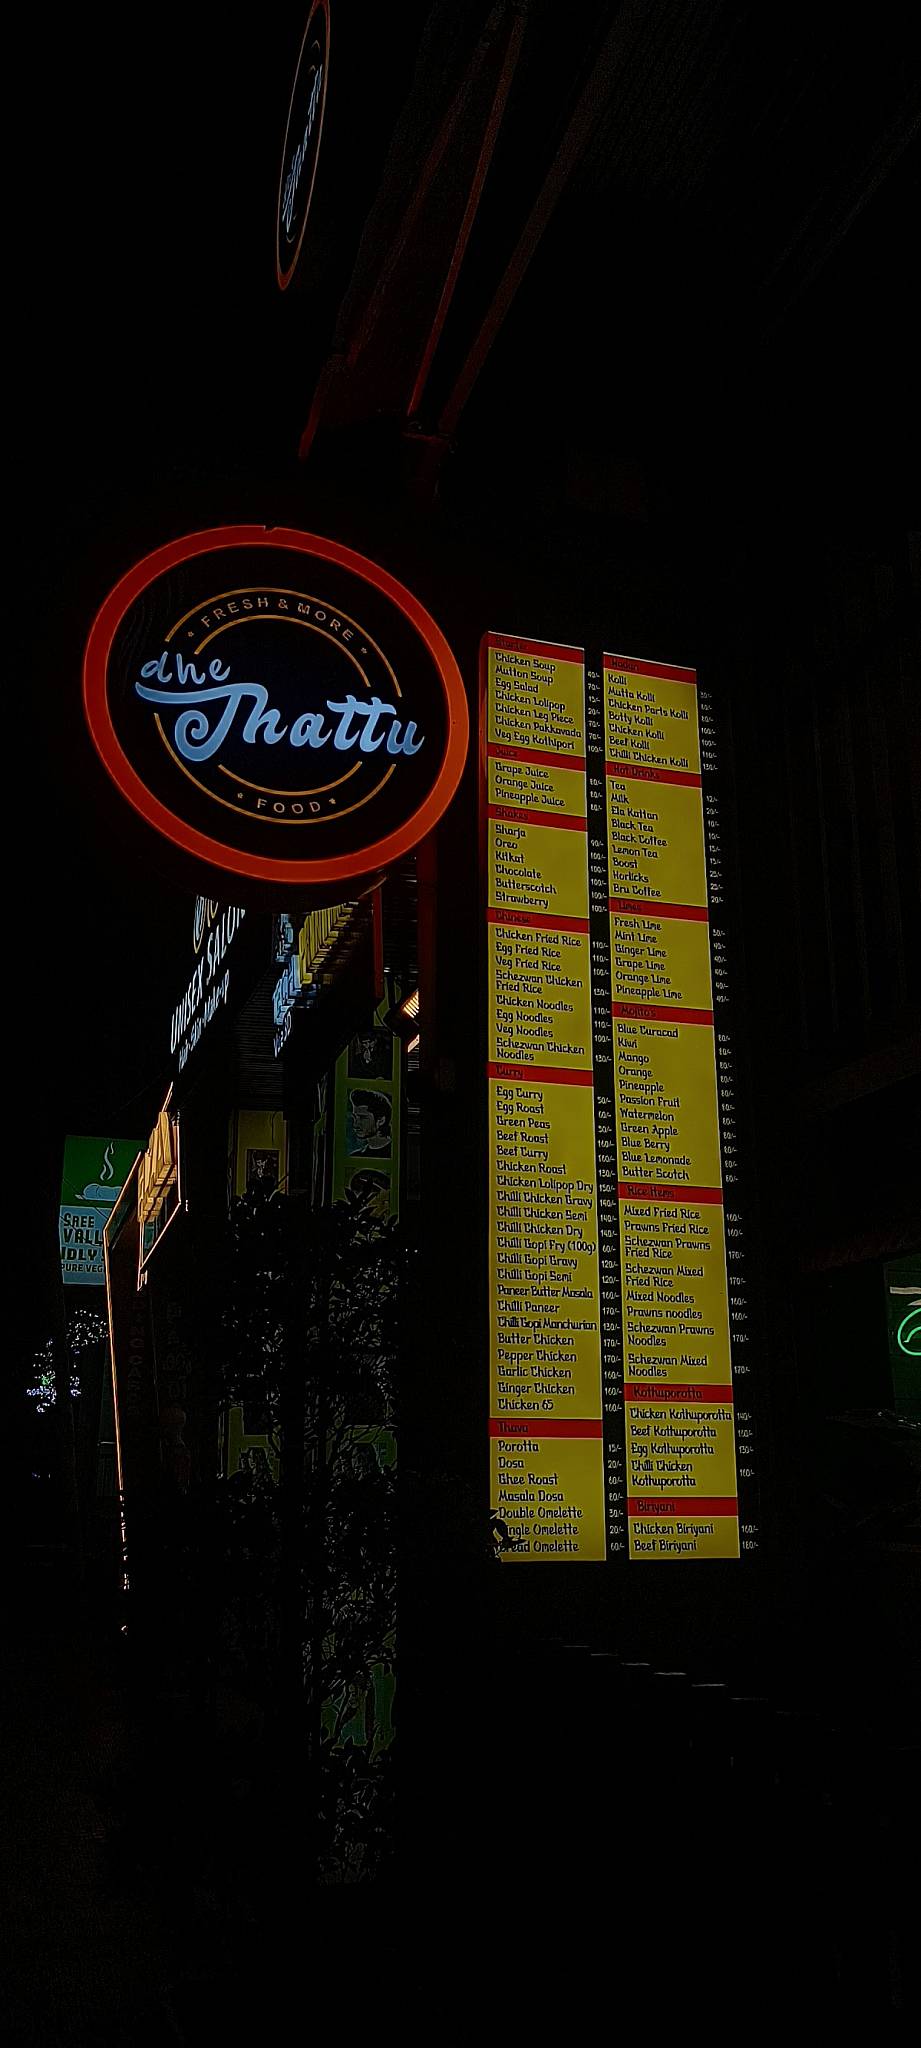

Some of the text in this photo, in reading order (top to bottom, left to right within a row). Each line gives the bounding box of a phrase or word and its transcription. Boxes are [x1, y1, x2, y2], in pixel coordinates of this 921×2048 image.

[201, 597, 355, 641] FRESH & MORE
[495, 676, 538, 693] Egg Salad
[607, 673, 627, 685] Kolli
[636, 690, 655, 703] Kolli
[135, 682, 425, 762] Thattu
[494, 714, 531, 730] Chicken
[494, 761, 549, 778] Grape Juice
[609, 779, 626, 791] Tea
[256, 797, 321, 814] FOOD
[610, 792, 629, 804] Milk
[495, 837, 518, 849] Oreo
[611, 831, 668, 846] Black Coffee
[495, 850, 524, 864] Kitkat
[612, 856, 637, 869] Boost
[494, 863, 542, 879] Chocolate
[612, 869, 649, 883] Horlicks
[495, 877, 557, 894] Butterscotch
[495, 890, 548, 909] Strawberry
[495, 927, 582, 947] Chicken Fried Rice
[615, 970, 671, 986] Orange Lime
[171, 956, 204, 1054] UNISEX
[496, 1008, 553, 1024] Egg Noodles
[617, 1036, 637, 1048] Kiwi
[618, 1050, 649, 1066] Mango
[618, 1064, 653, 1080] Orange
[496, 1085, 543, 1102] Egg Curry
[618, 1078, 664, 1096] Pineapple
[496, 1100, 544, 1115] Egg Roast
[619, 1107, 674, 1122] Watermelon
[495, 1115, 550, 1129] Green Peas
[496, 1129, 548, 1144] Beef Roast
[621, 1165, 690, 1180] Butter Scotch
[496, 1174, 536, 1188] Chicken
[576, 1180, 594, 1194] Dry
[496, 1190, 592, 1209] Chilli Chicken Gravy
[623, 1204, 701, 1219] Mixed Fried Rice
[64, 1213, 95, 1228] SREE
[623, 1219, 709, 1234] Prawns Fried Rice
[496, 1236, 522, 1248] Chilli
[549, 1239, 565, 1254] Fry
[567, 1240, 596, 1256] (100g)
[674, 1237, 710, 1250] Prawns
[61, 1246, 98, 1261] IDLY
[624, 1246, 673, 1259] Fried Rice
[60, 1263, 103, 1273] PURE VEG
[676, 1265, 703, 1277] Mixed
[625, 1274, 674, 1287] Fried Rice
[497, 1284, 593, 1298] Paneer Butter Masala
[626, 1289, 694, 1304] Mixed Noodles
[626, 1305, 702, 1319] Prawns noodles
[497, 1316, 520, 1328] Chilli
[678, 1323, 714, 1335] Prawns
[497, 1332, 574, 1346] Butter Chicken
[627, 1334, 666, 1346] Noodles
[679, 1354, 707, 1366] Mixed
[497, 1364, 571, 1378] Garlic Chicken
[628, 1364, 667, 1377] Noodles
[497, 1381, 574, 1397] Ginger Chicken
[497, 1398, 554, 1410] Chicken 65
[629, 1407, 666, 1419] Chicken
[630, 1424, 652, 1436] Beef
[497, 1439, 539, 1452] Porotta
[630, 1442, 648, 1458] Egg
[498, 1456, 524, 1468] Dosa
[630, 1459, 693, 1472] Chilli Chicken
[498, 1472, 558, 1485] Ghee Roast
[498, 1489, 564, 1502] Masala Dosa
[498, 1505, 583, 1519] Double Omelette
[507, 1522, 579, 1539] ingle Omelette
[633, 1522, 714, 1537] Chicken Biriyani
[633, 1538, 697, 1554] Beef Biriyani
